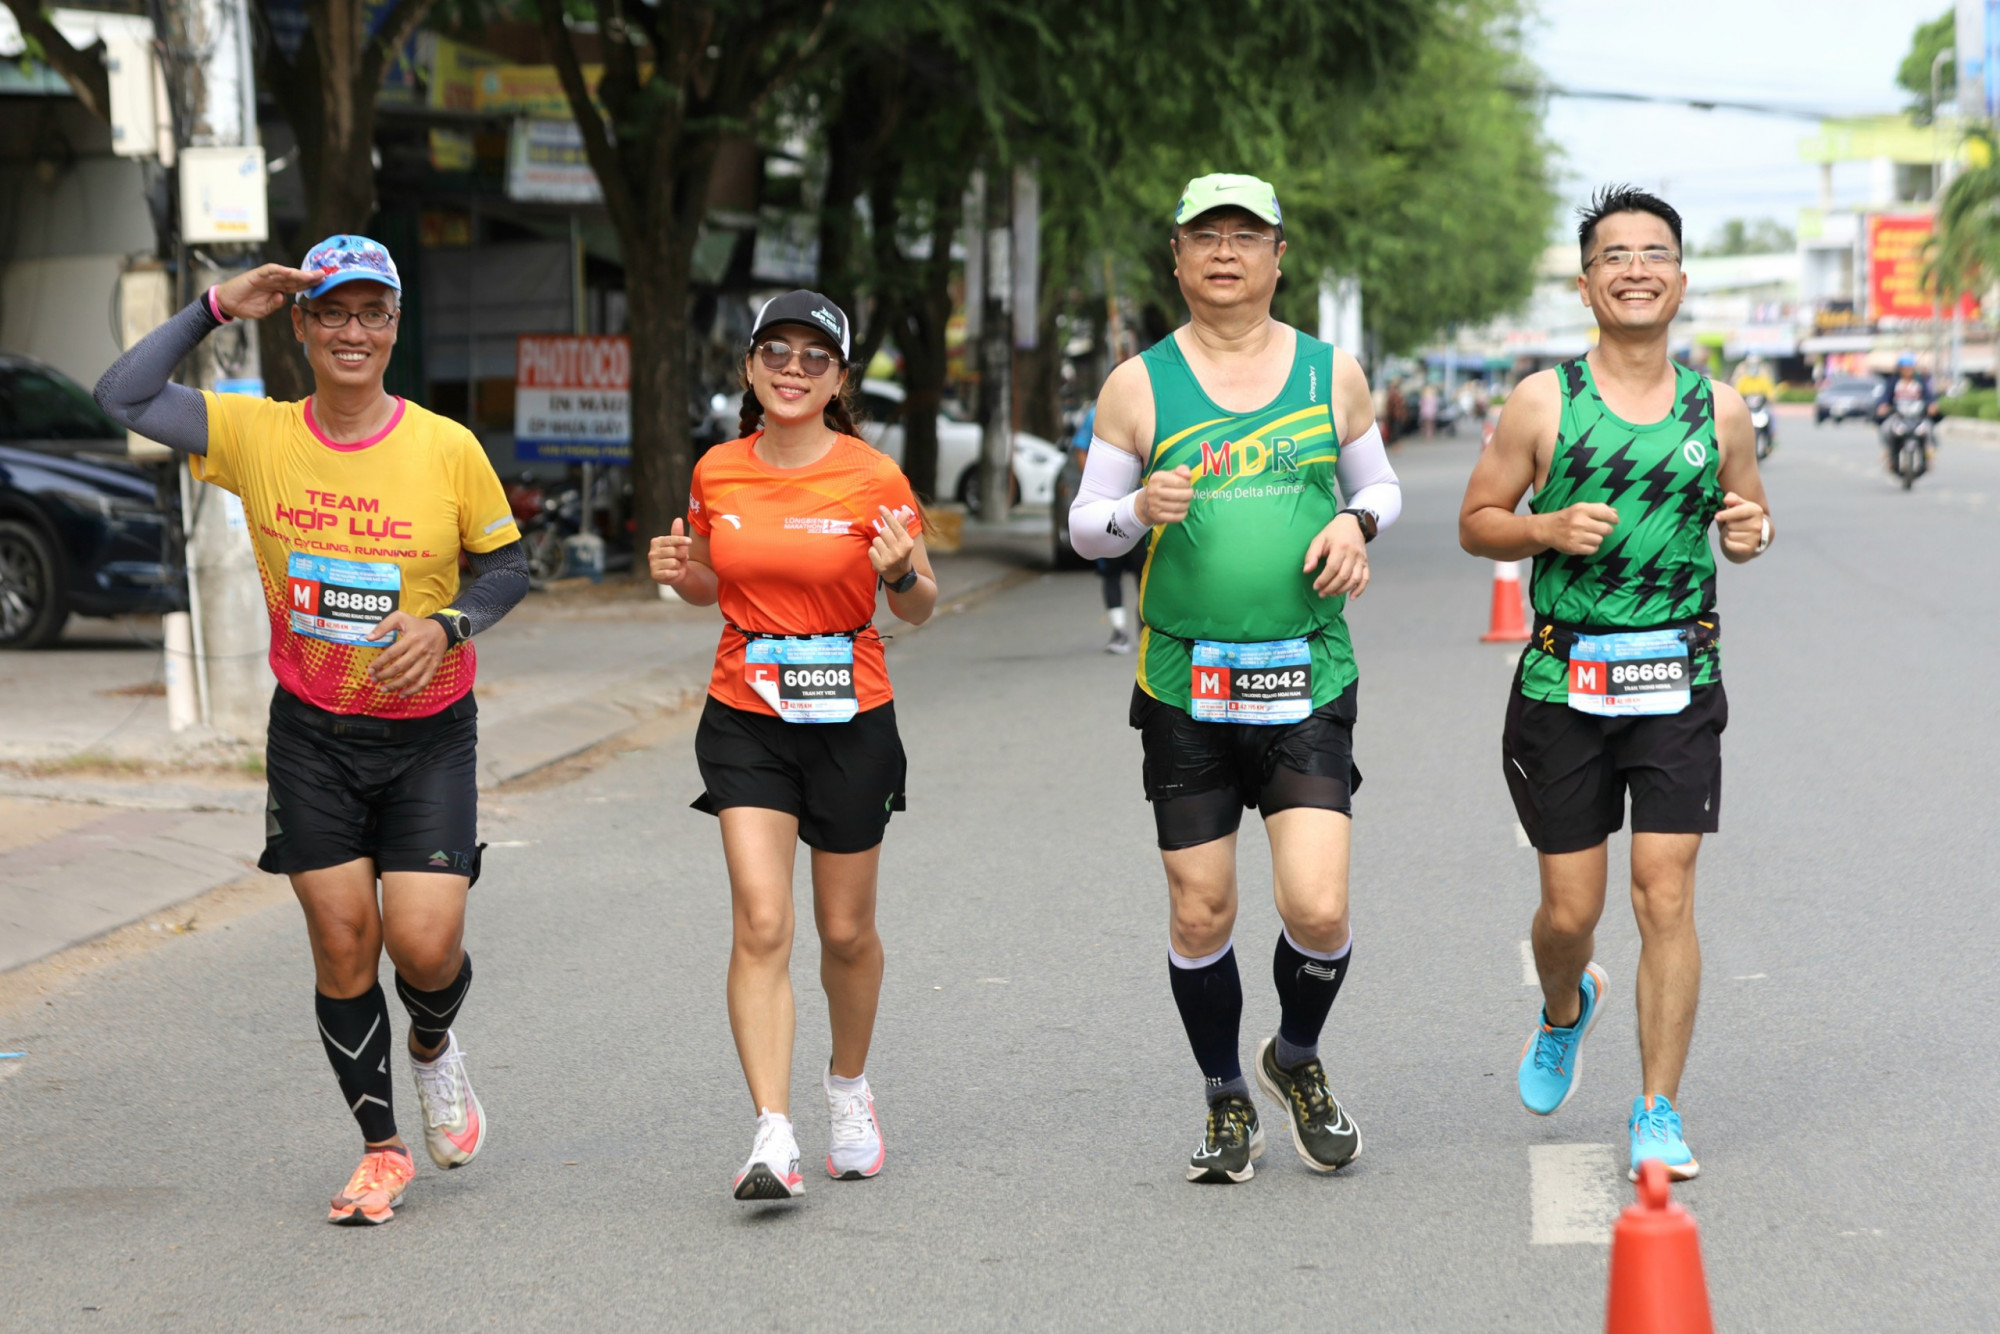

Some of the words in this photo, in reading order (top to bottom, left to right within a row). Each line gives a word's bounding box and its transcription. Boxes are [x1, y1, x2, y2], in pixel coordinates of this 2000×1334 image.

[1200, 436, 1299, 477] MDR
[305, 489, 379, 514] TEAM
[1234, 486, 1264, 499] Delta
[275, 502, 338, 533] HỢP
[349, 516, 412, 542] LỰC
[259, 523, 291, 543] HAPPY
[294, 537, 352, 554] CYCLING,
[354, 546, 418, 558] RUNNING
[293, 583, 311, 609] M
[323, 589, 393, 612] 88889
[784, 669, 851, 687] 60608
[1200, 671, 1219, 694] M
[1236, 670, 1306, 690] 42042
[1577, 666, 1596, 690] M
[1611, 661, 1683, 684] 86666
